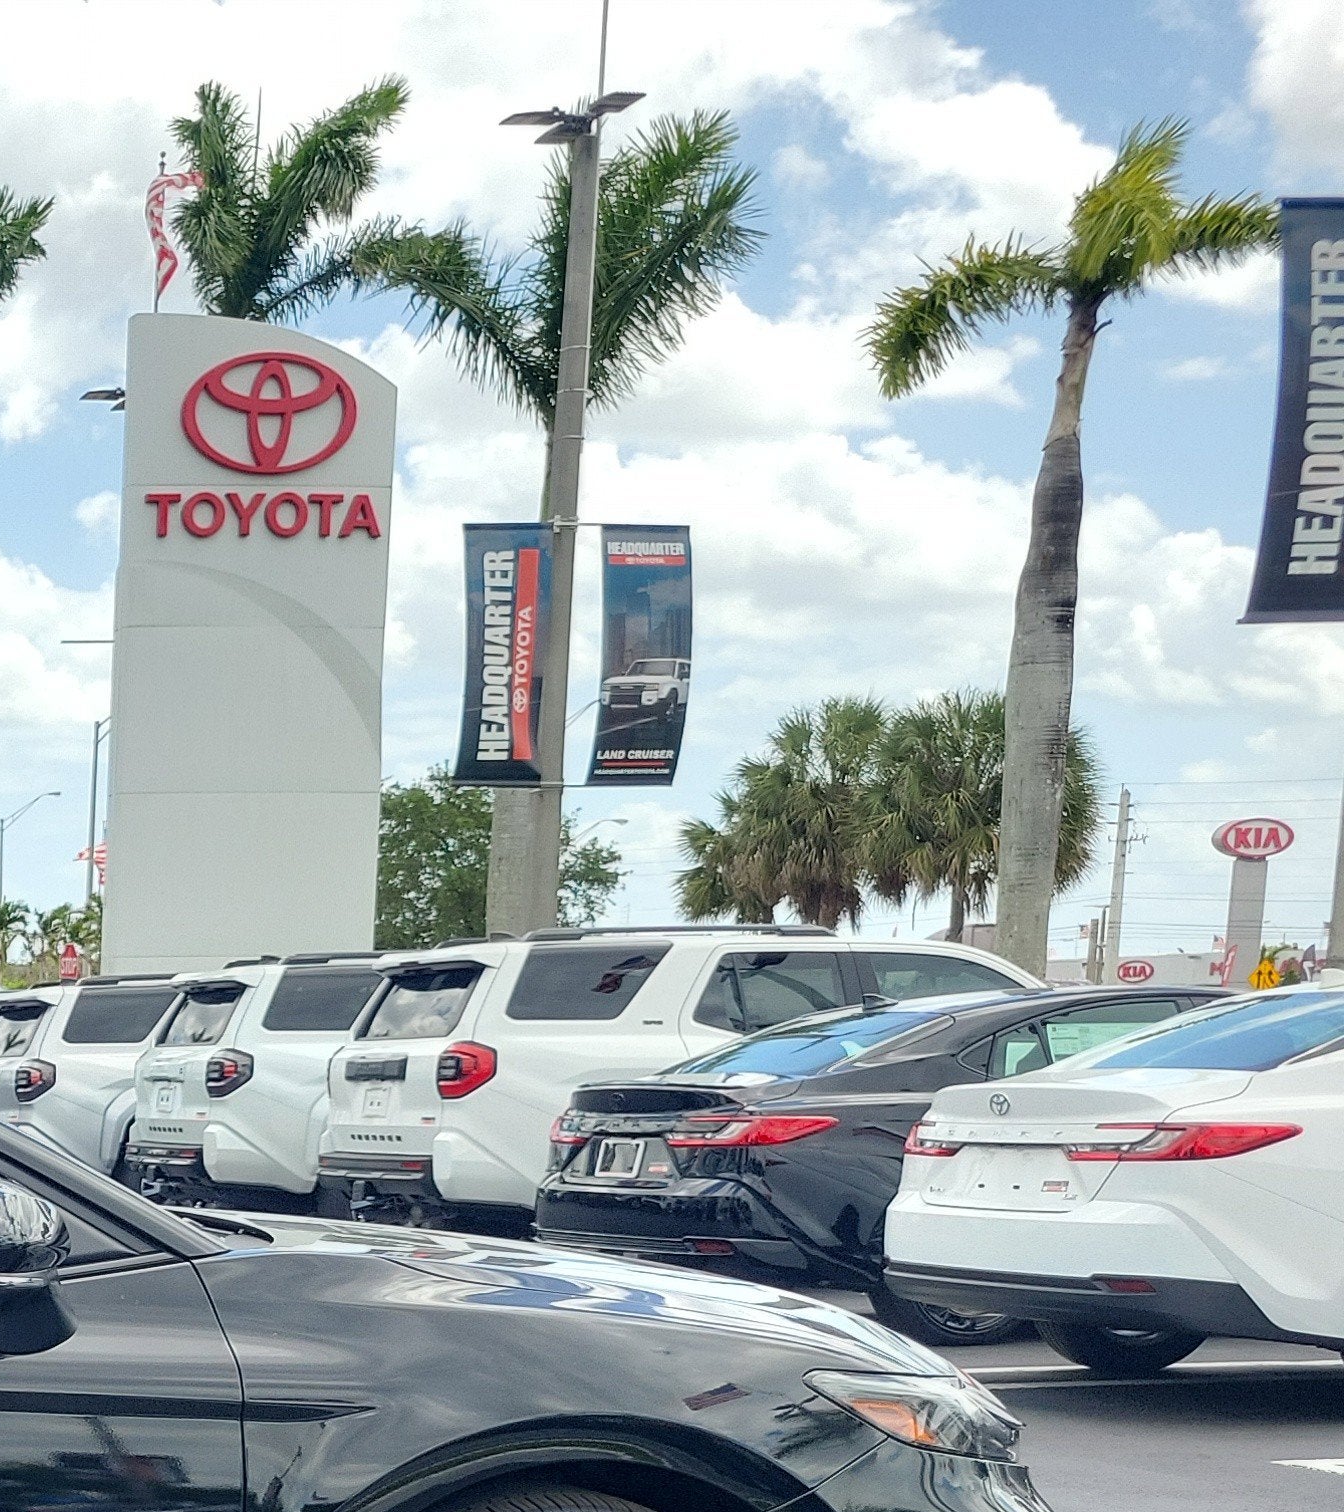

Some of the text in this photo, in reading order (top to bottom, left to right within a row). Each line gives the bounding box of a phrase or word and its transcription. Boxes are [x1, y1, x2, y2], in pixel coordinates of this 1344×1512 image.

[145, 491, 381, 538] TOYOTA
[607, 541, 685, 557] HEADQUARTER
[476, 550, 515, 761] HEADQUARTER
[514, 605, 533, 688] TOYOTA
[596, 749, 675, 760] LAND CRUISER
[1234, 827, 1283, 849] KIA
[61, 957, 77, 975] STOP
[1121, 964, 1148, 978] KIA
